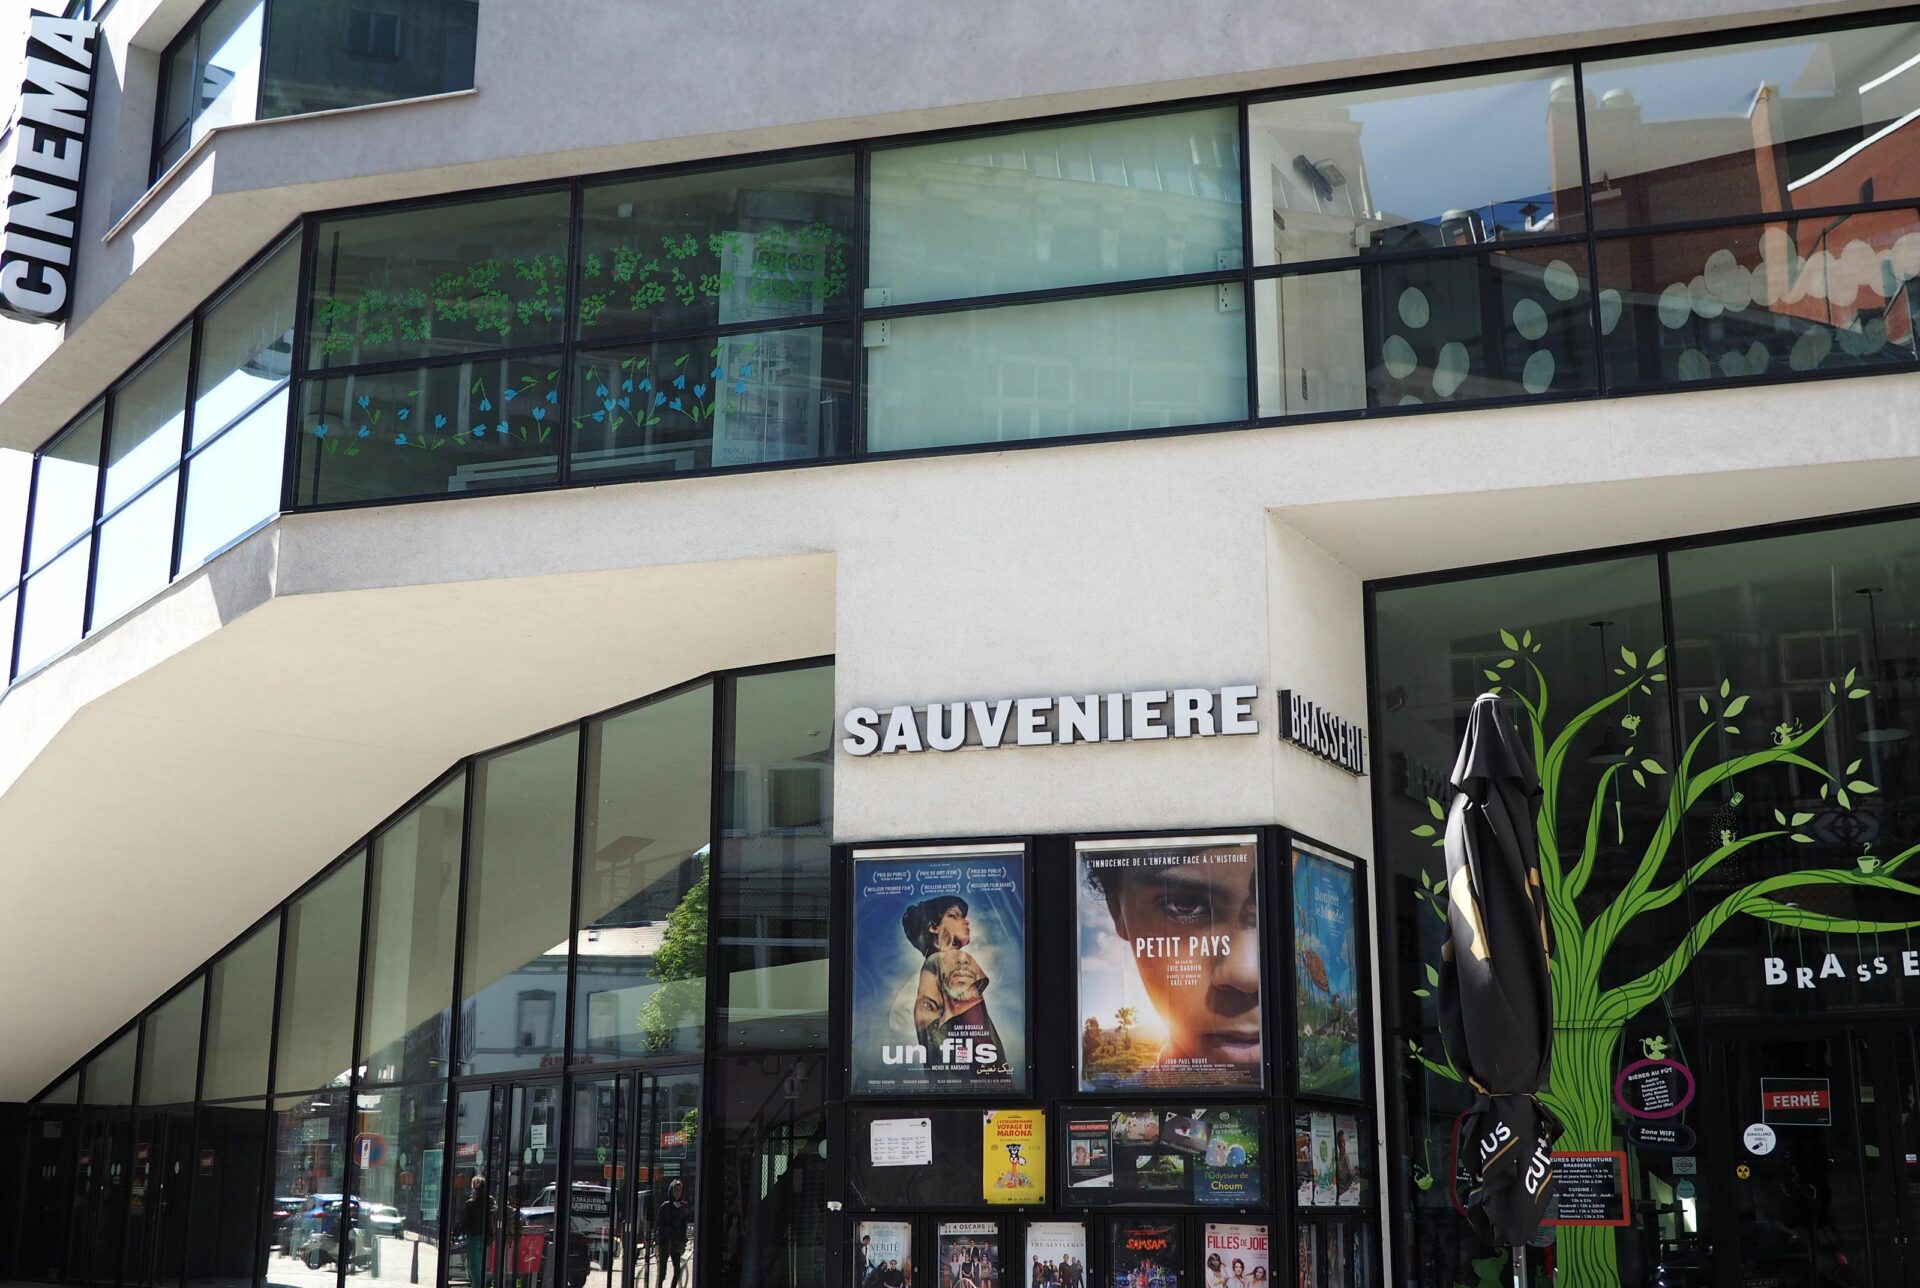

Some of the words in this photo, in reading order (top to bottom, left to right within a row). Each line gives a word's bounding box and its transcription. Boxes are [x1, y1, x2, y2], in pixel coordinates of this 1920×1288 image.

[0, 18, 98, 317] CINEMA
[842, 684, 1258, 756] SAUVENIERE
[1087, 859, 1130, 868] L'INNOCENCE
[1133, 859, 1141, 867] DE
[1143, 857, 1181, 866] L'ENFANCE
[1183, 856, 1200, 864] FACE
[1202, 854, 1208, 863] À
[1210, 854, 1248, 863] L'HISTOIRE
[1136, 937, 1181, 958] PETIT
[1189, 935, 1231, 957] PAYS
[882, 1045, 927, 1064] un
[940, 1038, 998, 1064] fils
[1628, 1072, 1650, 1081] BIÈRES
[1772, 1091, 1820, 1108] FERMÉ
[1211, 1181, 1243, 1190] Choum
[870, 1241, 899, 1252] VÉRITÉ
[1126, 1238, 1167, 1250] SAMSAM
[1207, 1236, 1240, 1250] FILLES
[1240, 1239, 1248, 1247] DE
[1247, 1236, 1268, 1251] JOIE
